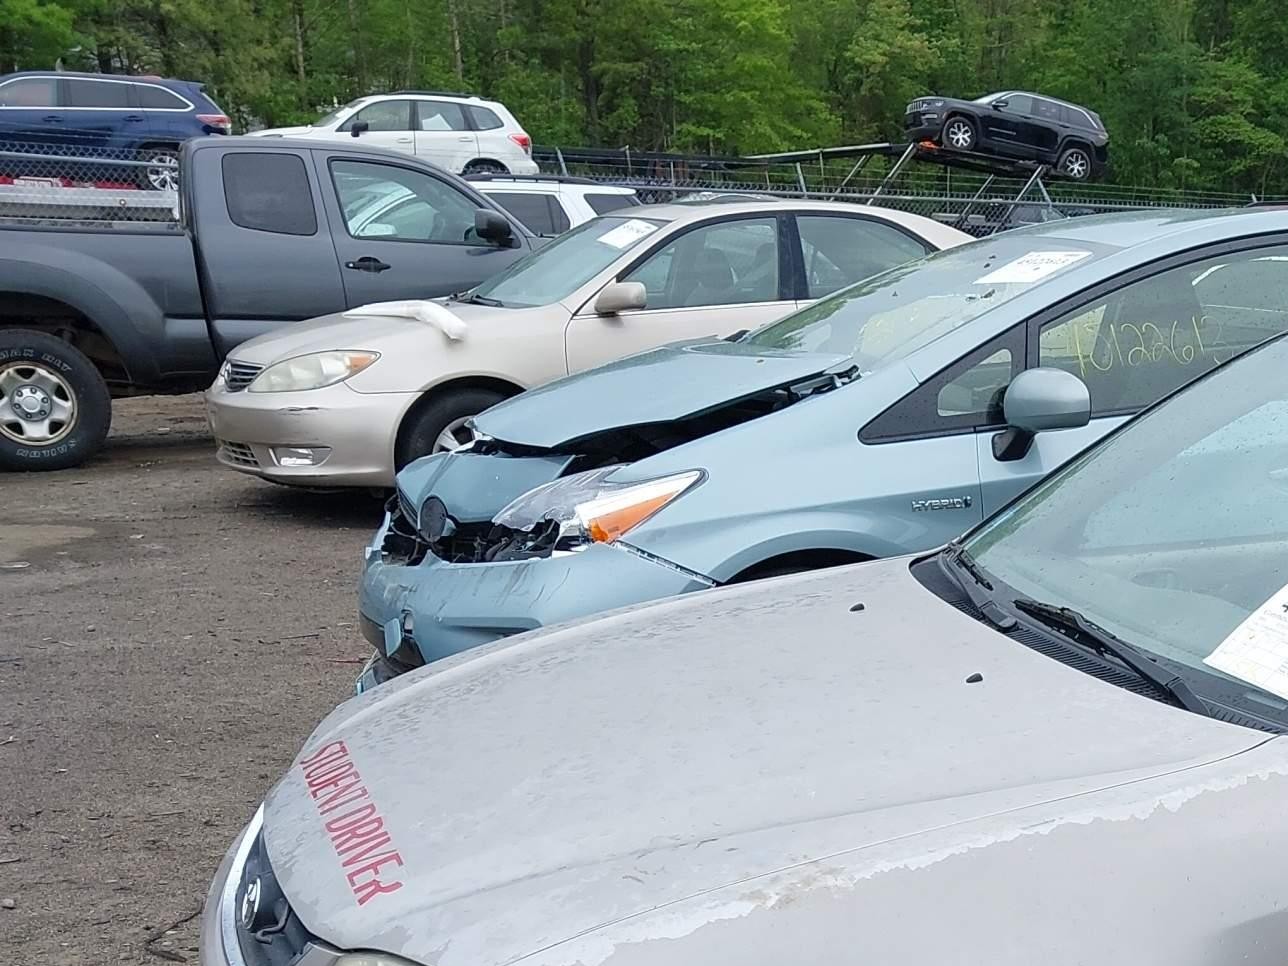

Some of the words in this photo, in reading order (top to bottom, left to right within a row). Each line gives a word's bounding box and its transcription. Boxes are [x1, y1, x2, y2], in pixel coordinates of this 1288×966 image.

[911, 497, 963, 512] HYBRID
[299, 740, 370, 816] STUDENT
[325, 802, 404, 907] DRIVER
